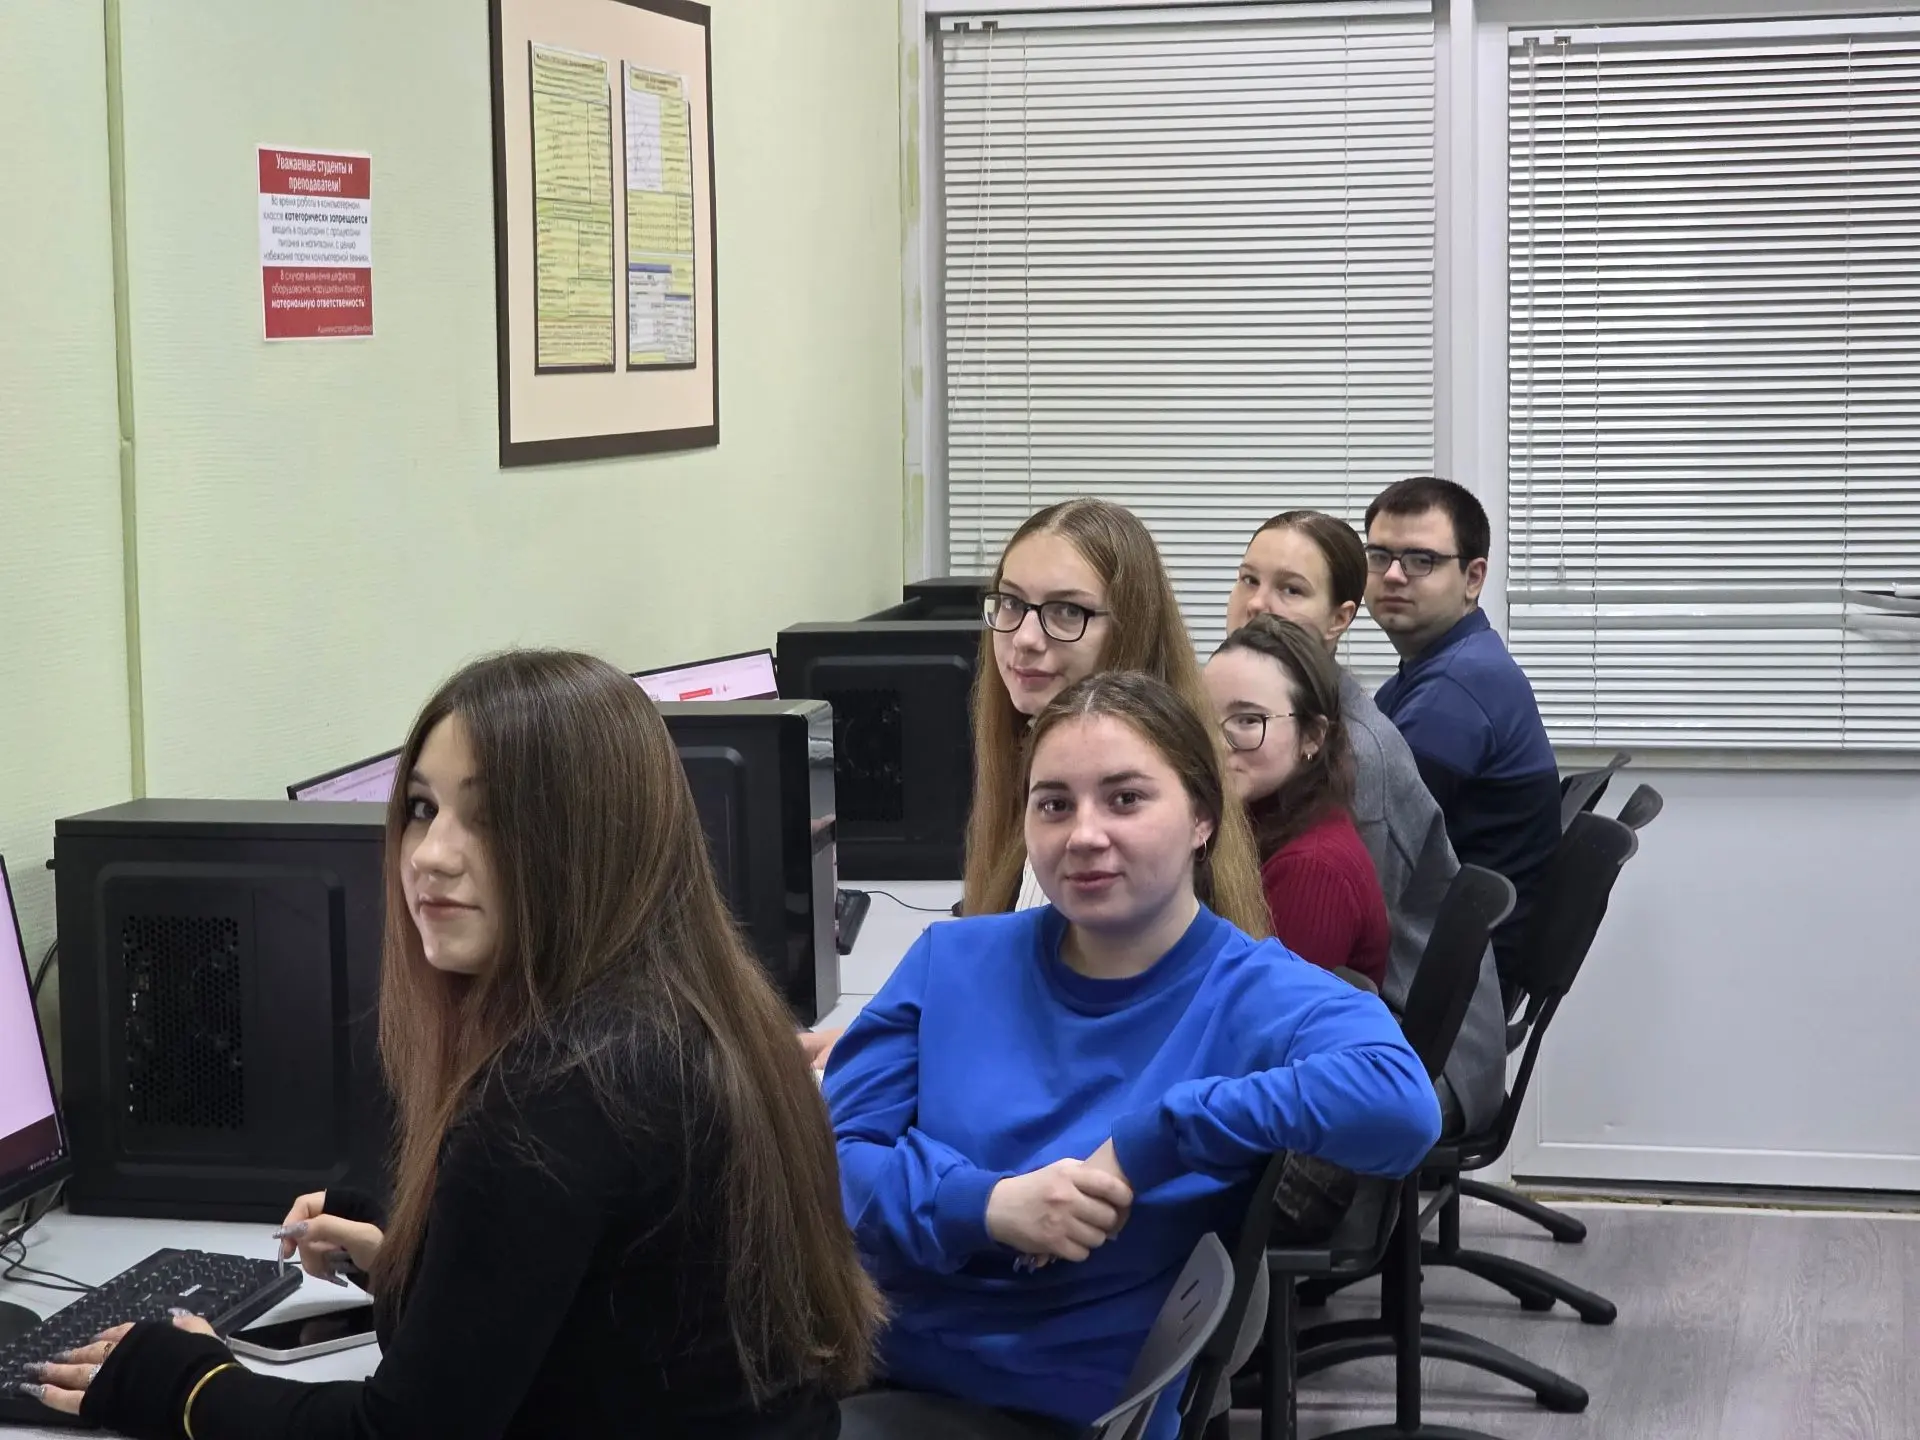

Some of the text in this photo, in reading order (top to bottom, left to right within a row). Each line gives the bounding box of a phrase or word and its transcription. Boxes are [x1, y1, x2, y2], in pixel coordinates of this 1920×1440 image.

[276, 153, 353, 176] Уважаемые студенты и
[288, 176, 341, 193] преподаватели!
[285, 212, 329, 223] категорически
[329, 214, 368, 224] запрещается
[271, 299, 316, 310] материальную
